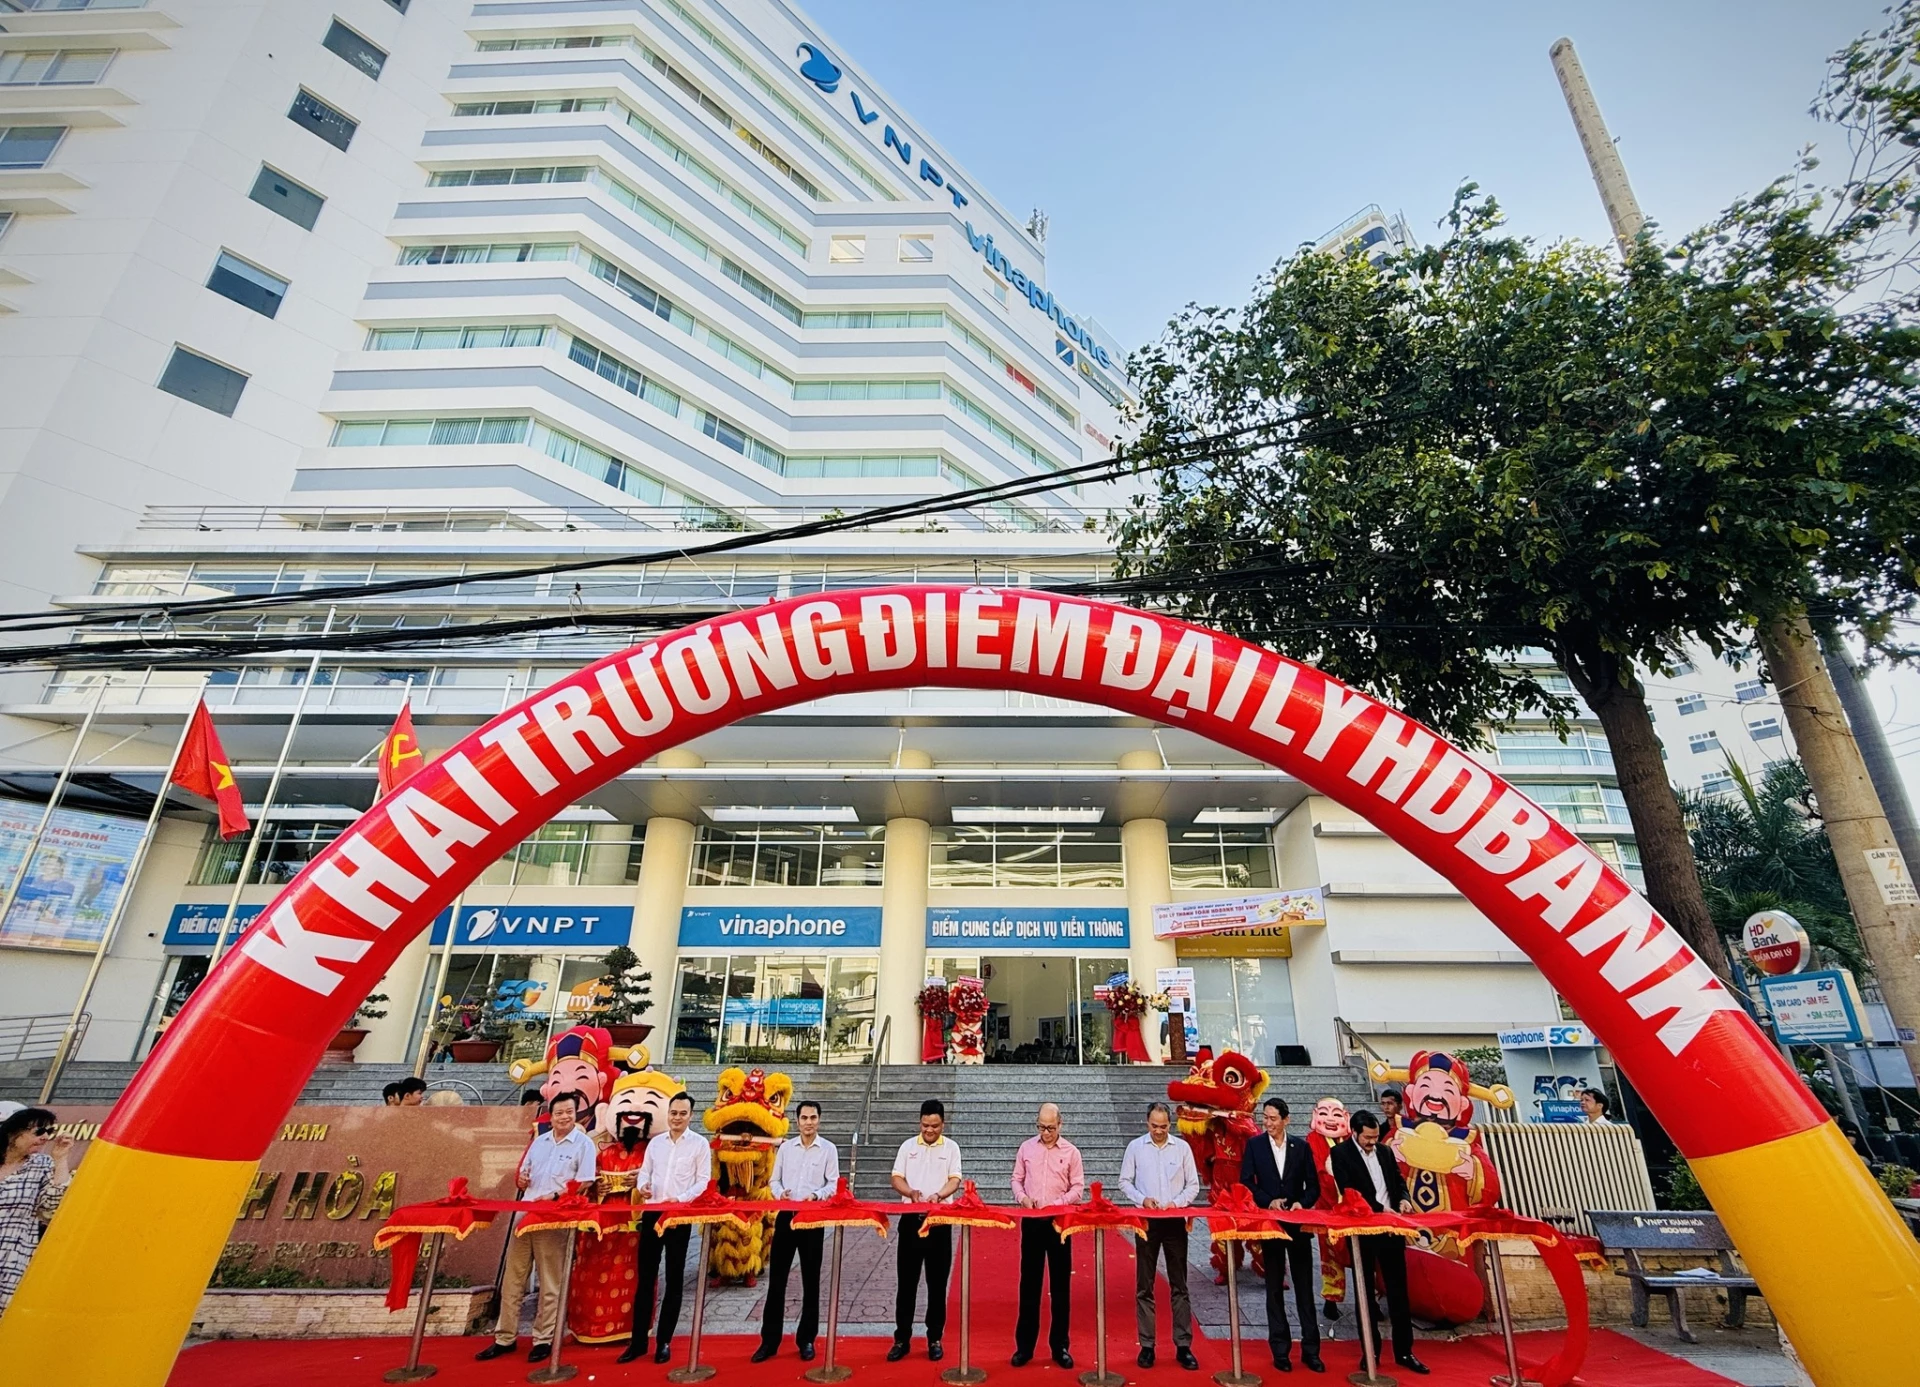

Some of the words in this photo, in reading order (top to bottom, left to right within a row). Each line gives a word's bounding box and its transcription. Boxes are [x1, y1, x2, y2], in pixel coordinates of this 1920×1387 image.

[850, 90, 968, 209] VNPT
[965, 220, 1111, 370] vinaphone
[241, 752, 517, 997] KHAI
[480, 600, 853, 797] TRƯƠNG
[1101, 611, 1263, 722] ĐẠI
[1346, 710, 1745, 1058] HDBANK
[207, 917, 239, 934] CUG
[502, 916, 600, 934] VNPT
[719, 913, 846, 939] vinaphone
[932, 915, 958, 937] ĐIỂM
[962, 920, 990, 937] CUNG
[992, 916, 1014, 937] CẤP
[1016, 920, 1040, 940] DỊCH
[1043, 920, 1058, 940] VỤ
[1061, 916, 1085, 937] VIỄN
[1088, 917, 1124, 937] THÔNG
[1748, 923, 1764, 937] HD
[1752, 933, 1780, 948] Bank
[1776, 999, 1786, 1007] SIM
[1786, 998, 1802, 1007] CARD
[1806, 996, 1816, 1005] SIM
[1500, 1031, 1545, 1046] vinaphone
[1548, 1104, 1582, 1114] vinapho
[280, 1123, 330, 1142] NAM
[1643, 1218, 1668, 1226] VNPT
